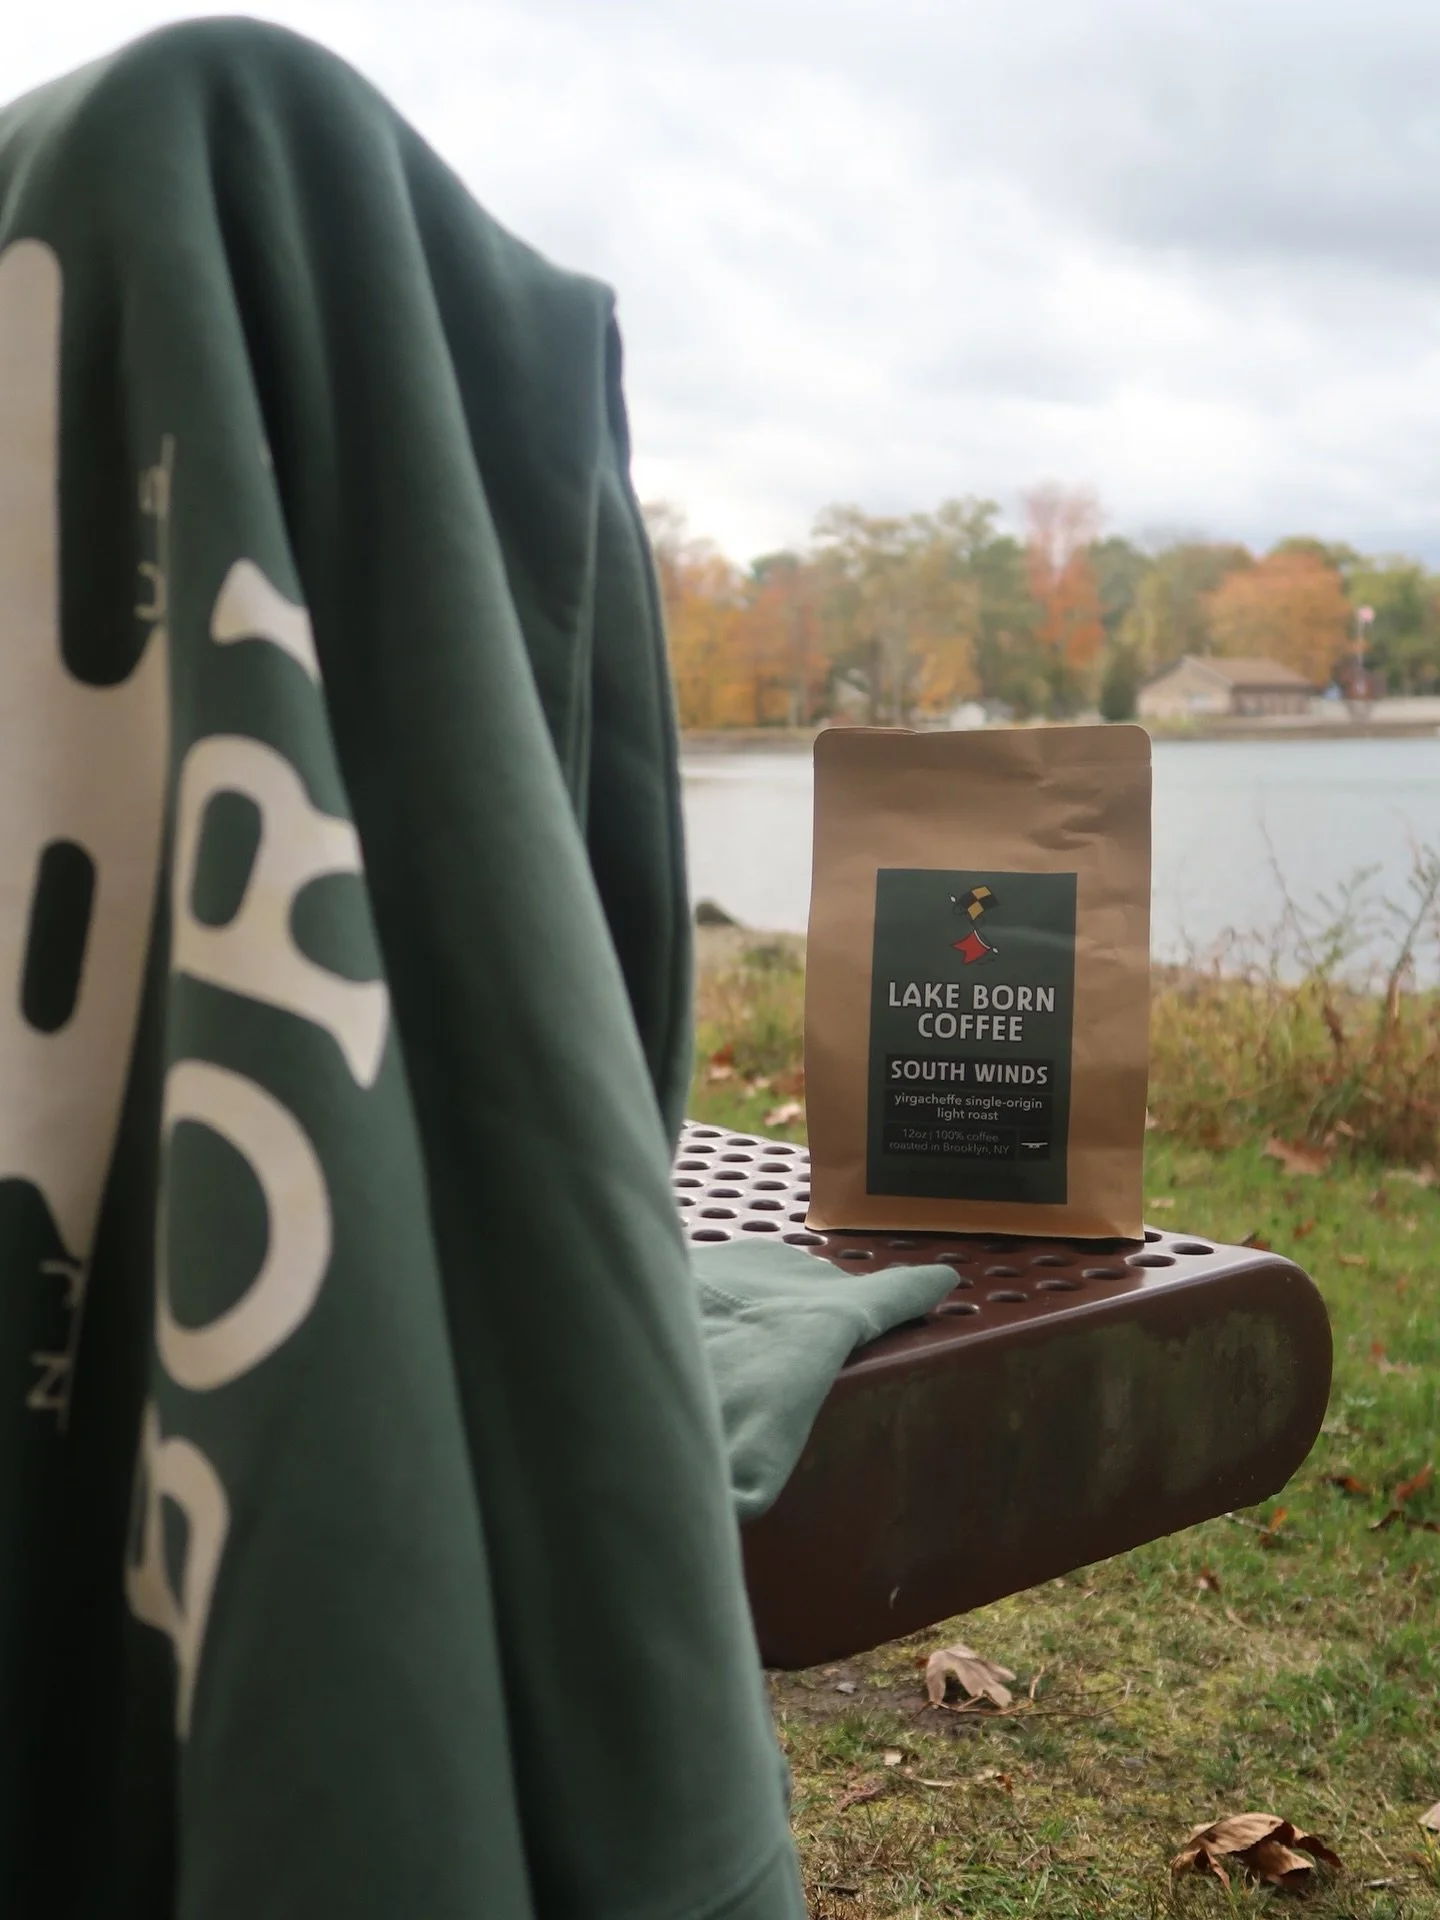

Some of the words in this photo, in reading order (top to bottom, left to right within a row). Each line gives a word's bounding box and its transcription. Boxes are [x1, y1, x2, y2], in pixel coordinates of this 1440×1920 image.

[888, 981, 960, 1009] LAKE
[973, 984, 1055, 1012] BORN
[918, 1012, 1023, 1042] COFFEE
[891, 1060, 965, 1082] SOUTH
[974, 1063, 1048, 1085] WINDS
[894, 1092, 962, 1107] yirgacheffe
[965, 1095, 1043, 1111] single-origin
[937, 1107, 965, 1121] light
[967, 1110, 999, 1121] roast
[903, 1128, 927, 1140] 12oz
[935, 1130, 964, 1142] 100%
[966, 1131, 999, 1143] coffee
[889, 1140, 928, 1151] roasted
[931, 1142, 940, 1151] in
[943, 1142, 992, 1156] Brooklyn,
[993, 1144, 1010, 1155] NY
